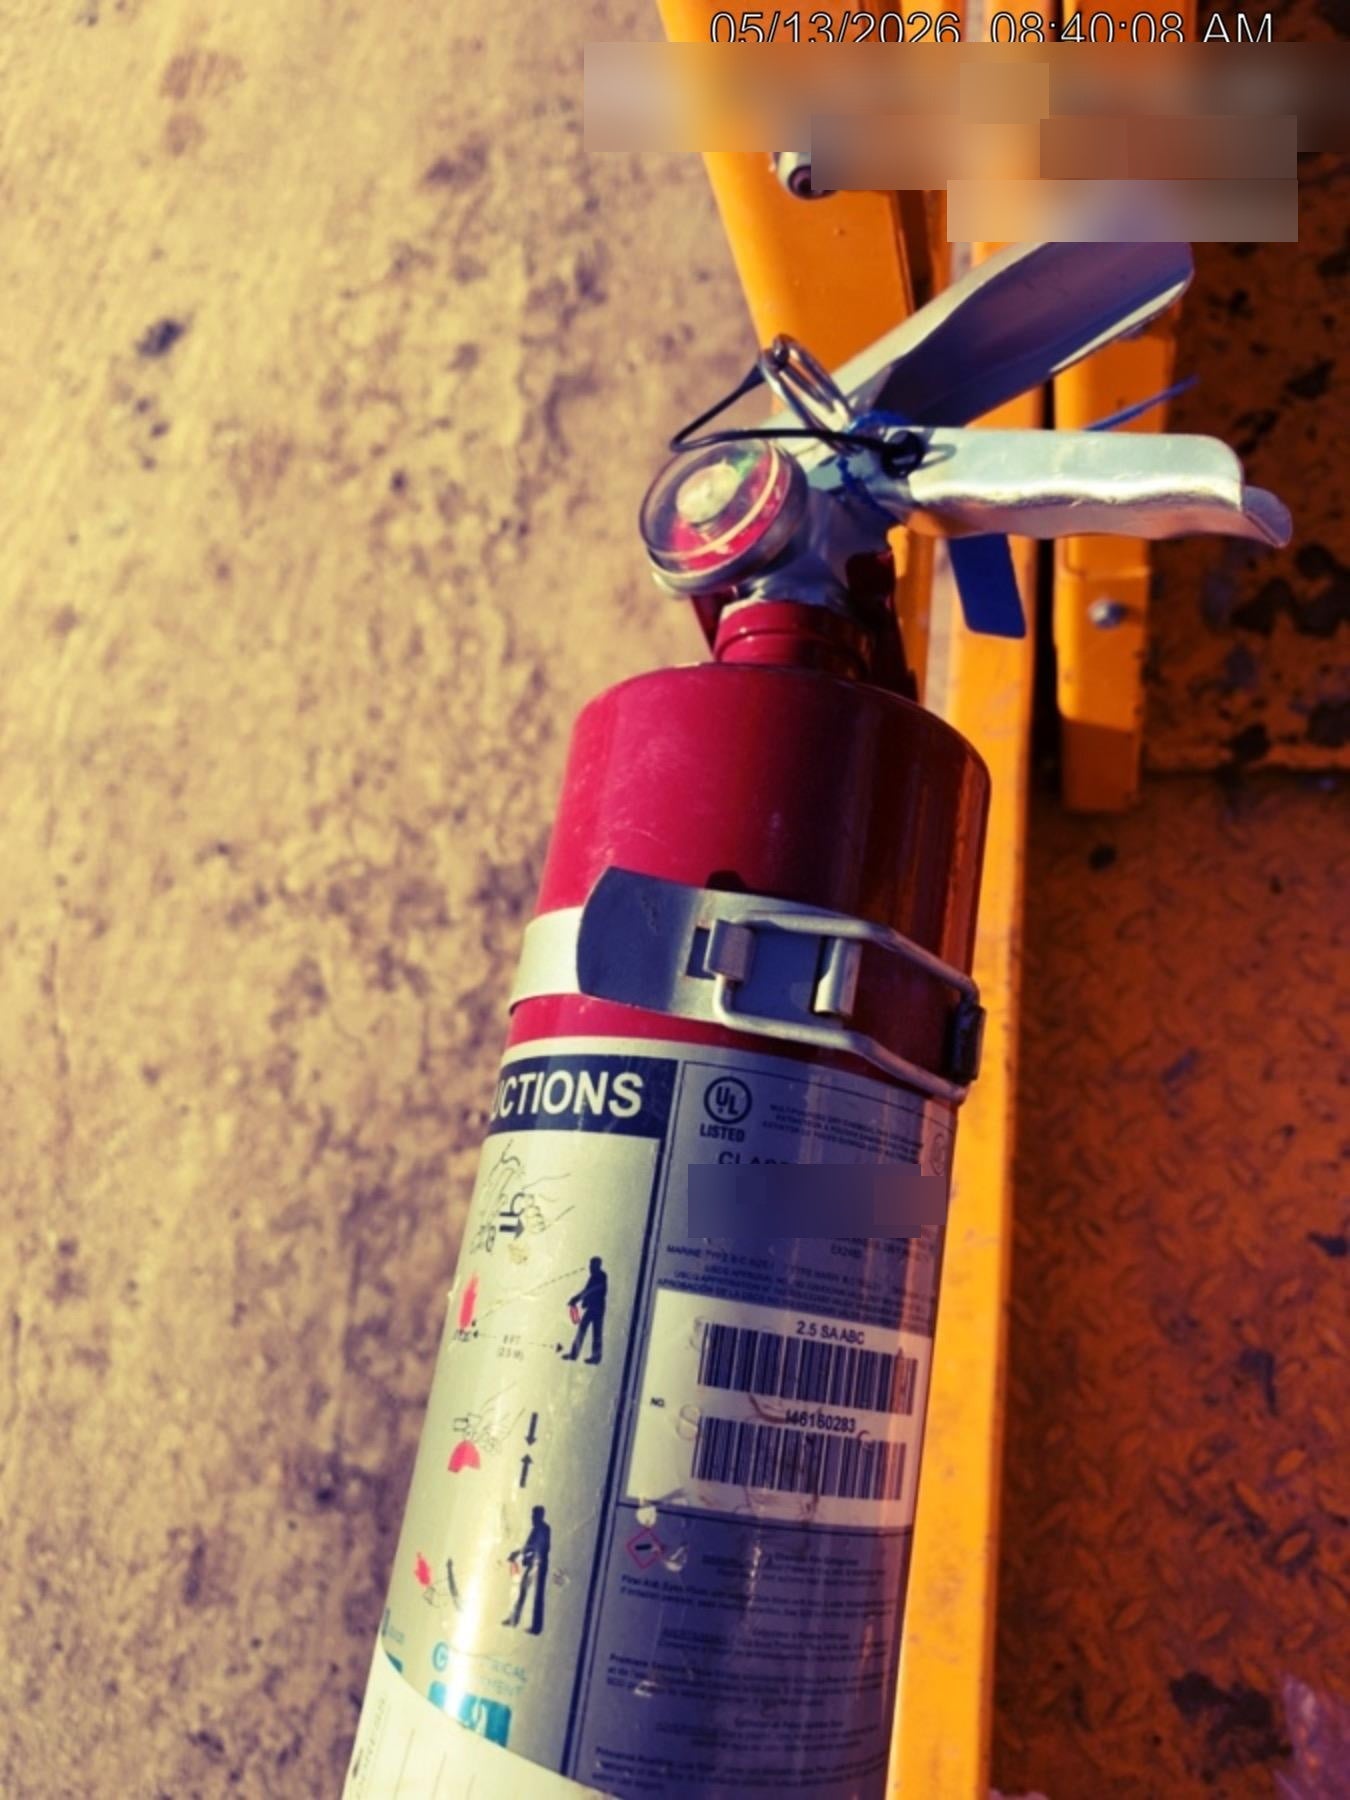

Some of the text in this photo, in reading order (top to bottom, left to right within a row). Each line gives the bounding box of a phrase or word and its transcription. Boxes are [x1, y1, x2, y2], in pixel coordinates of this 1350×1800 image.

[700, 1124, 745, 1142] LISTED
[796, 1320, 865, 1346] 2.5 SA ABC
